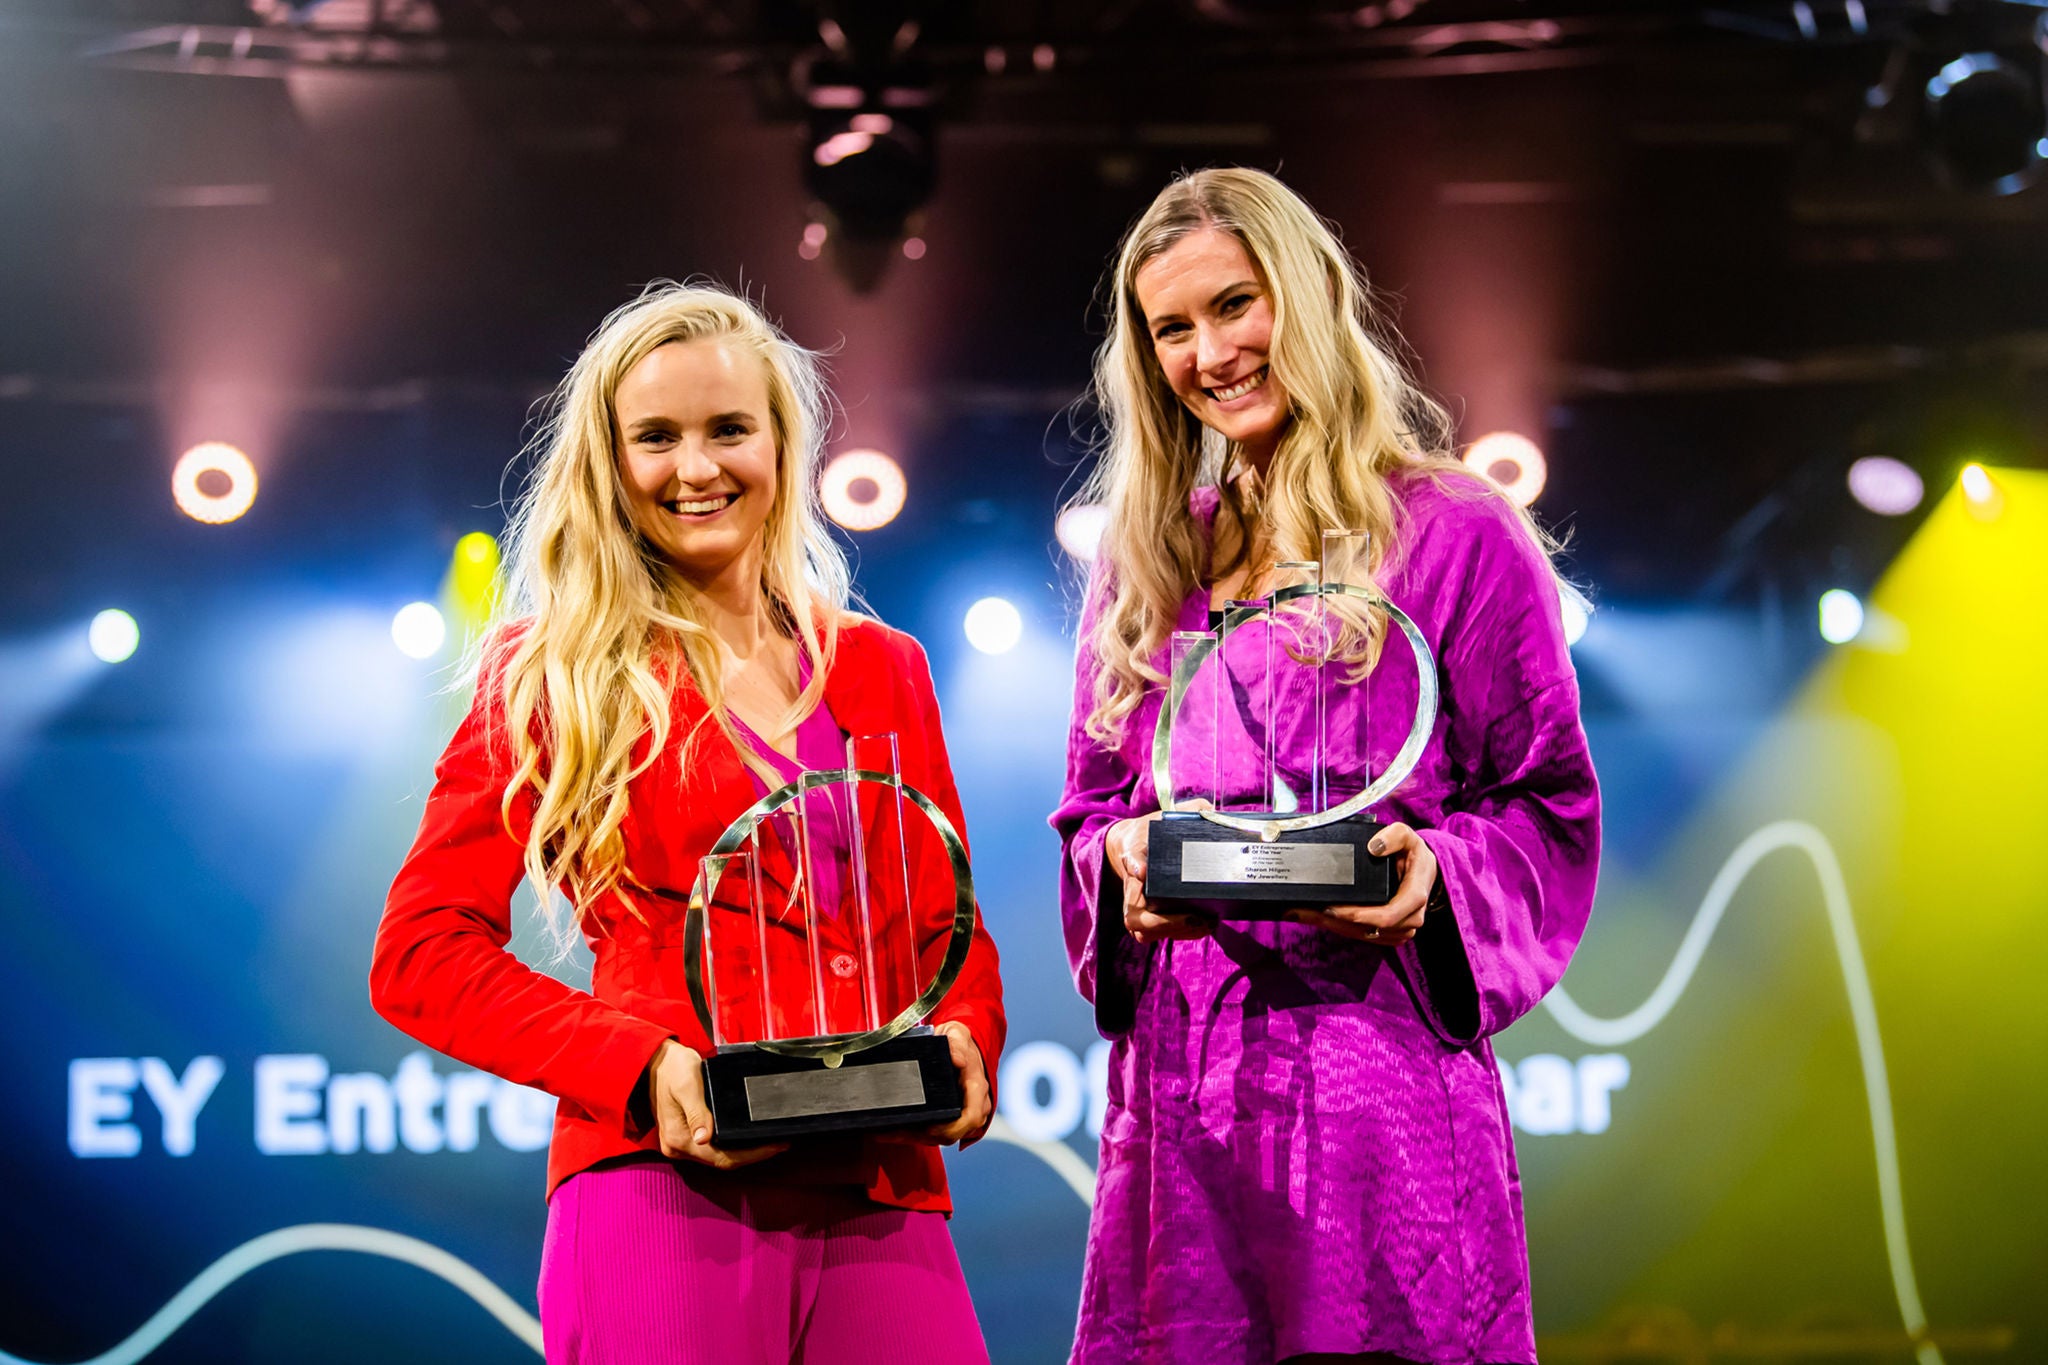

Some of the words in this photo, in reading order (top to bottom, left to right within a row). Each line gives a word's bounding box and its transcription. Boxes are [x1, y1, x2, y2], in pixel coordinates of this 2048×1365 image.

[67, 1055, 226, 1158] EY
[253, 1050, 558, 1156] Entre
[1498, 1053, 1630, 1135] ar
